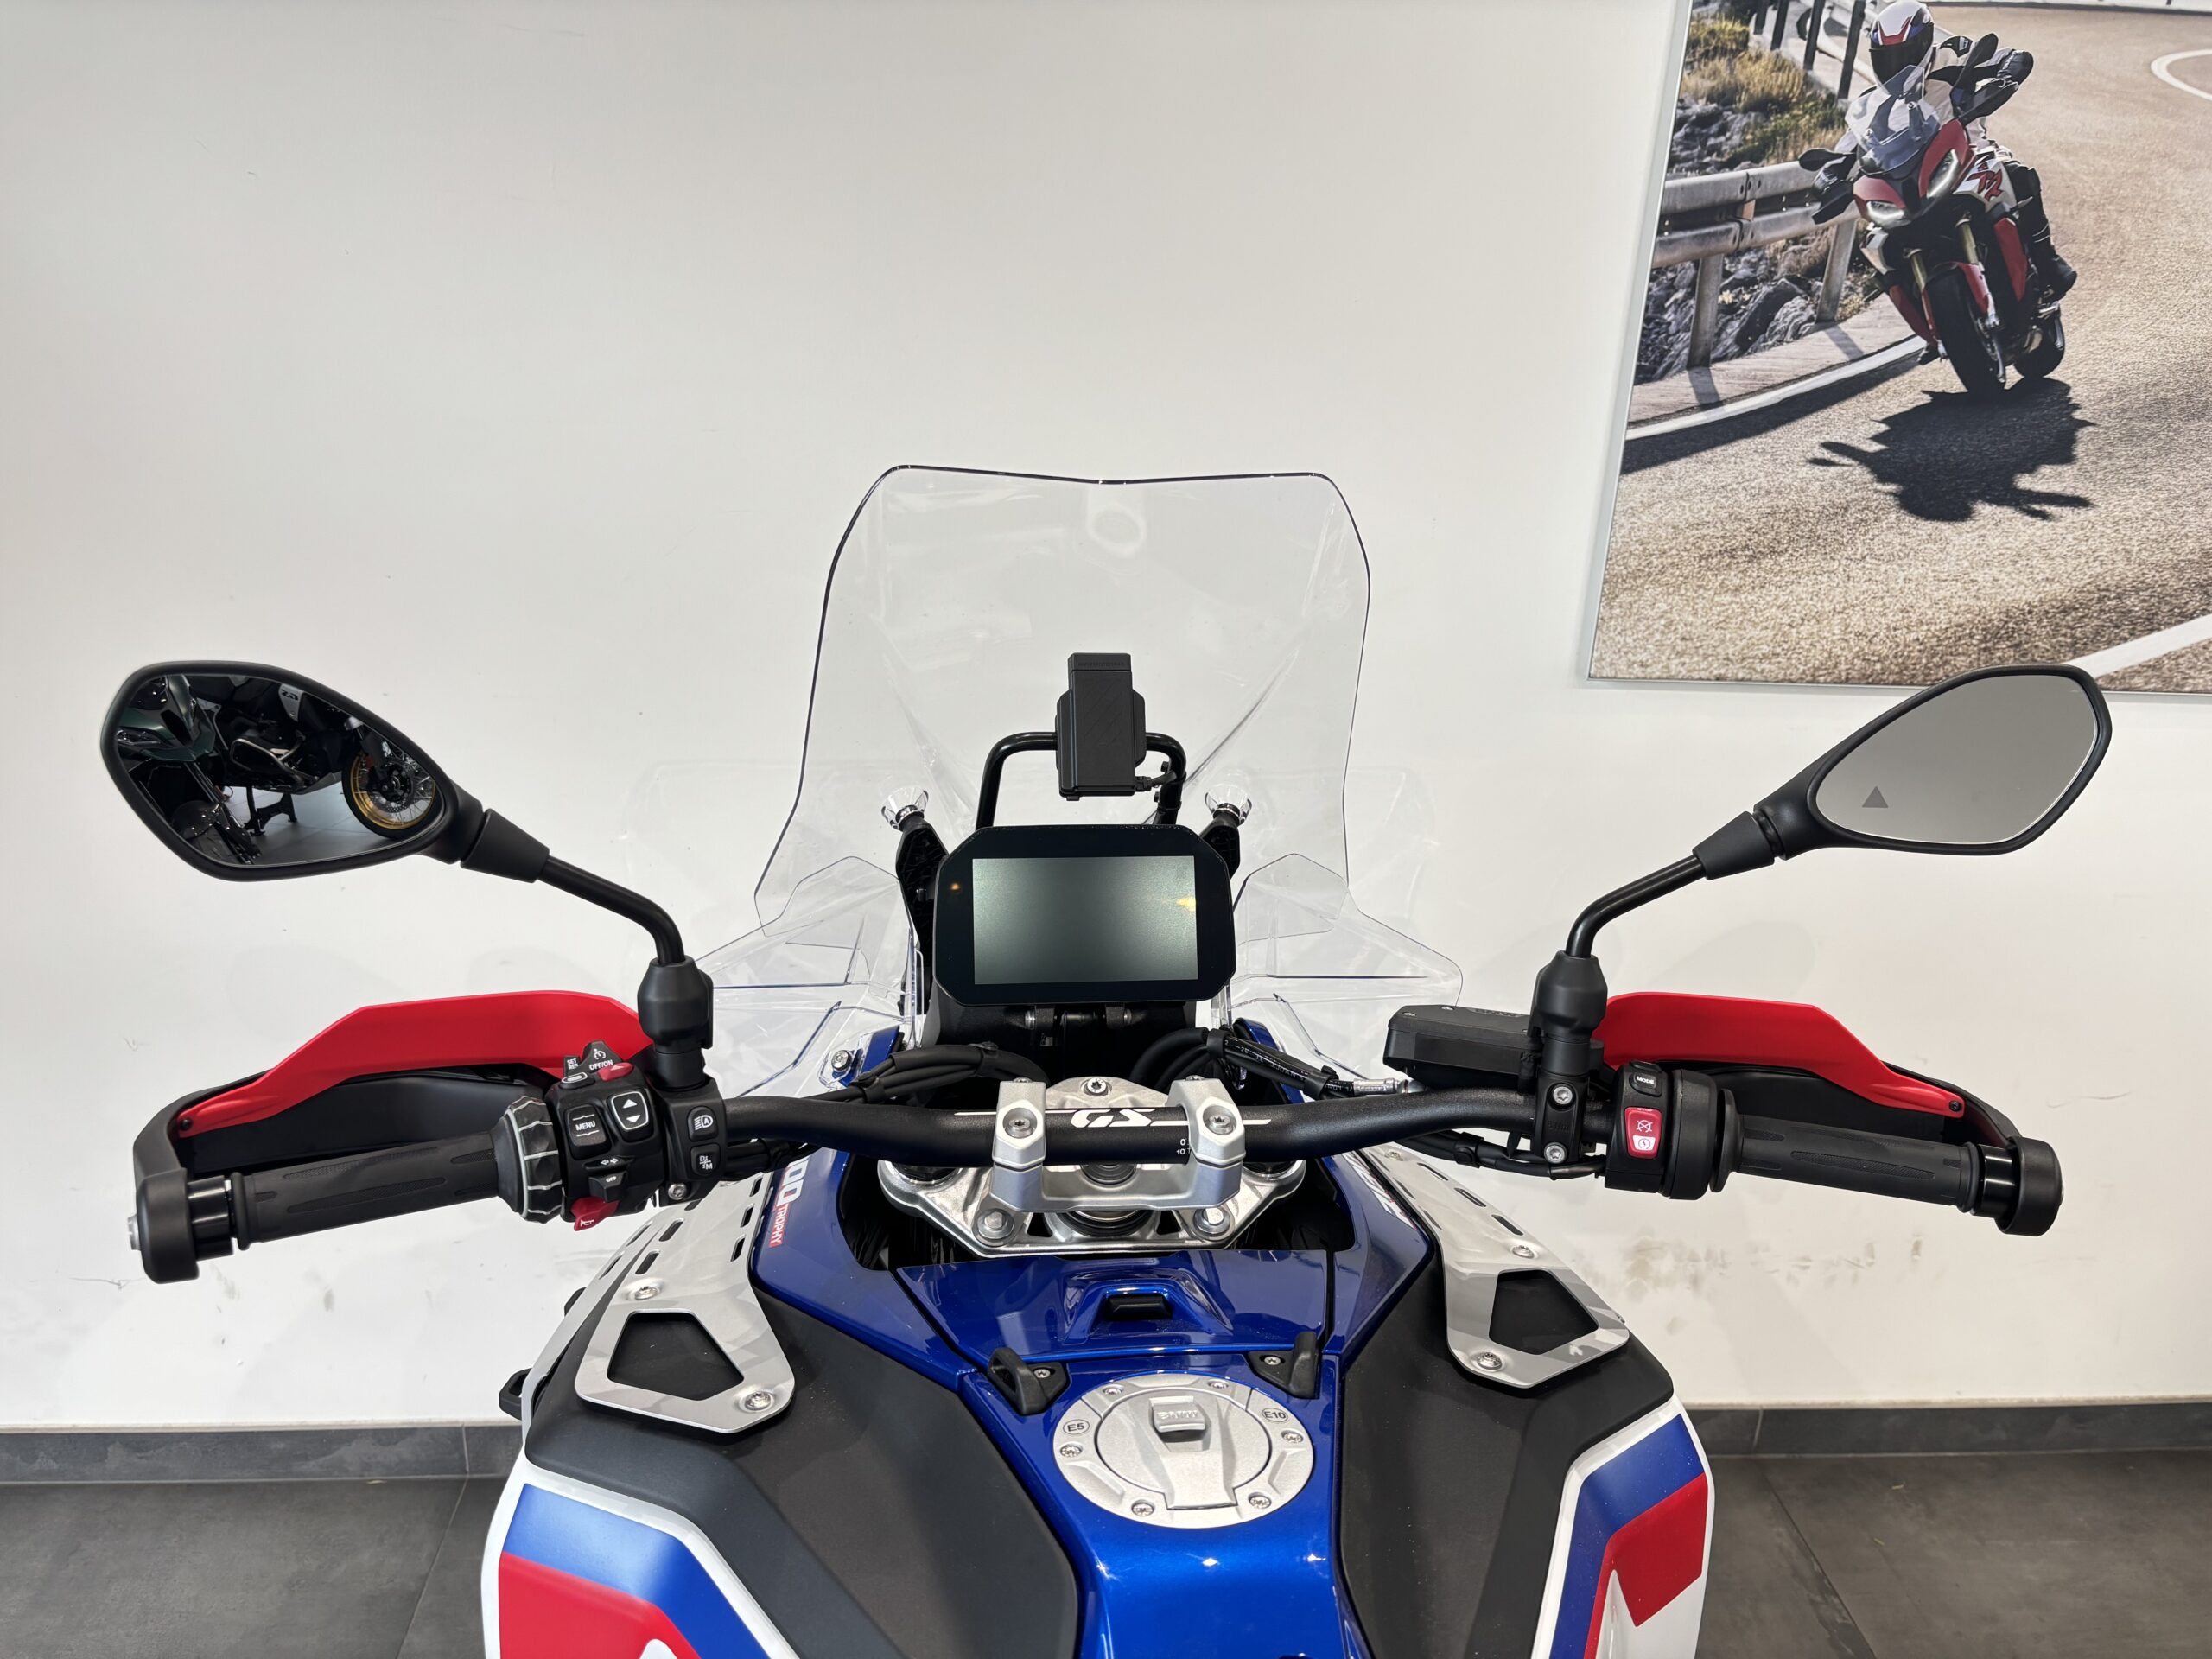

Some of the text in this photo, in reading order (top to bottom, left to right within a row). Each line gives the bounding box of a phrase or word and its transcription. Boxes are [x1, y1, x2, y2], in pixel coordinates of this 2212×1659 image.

[589, 1059, 613, 1071] OFF/ON
[1636, 1076, 1655, 1084] MODE
[1071, 1109, 1156, 1128] GS
[575, 1121, 596, 1131] MENU
[770, 1204, 789, 1244] TROPHY
[1067, 1422, 1085, 1432] E5
